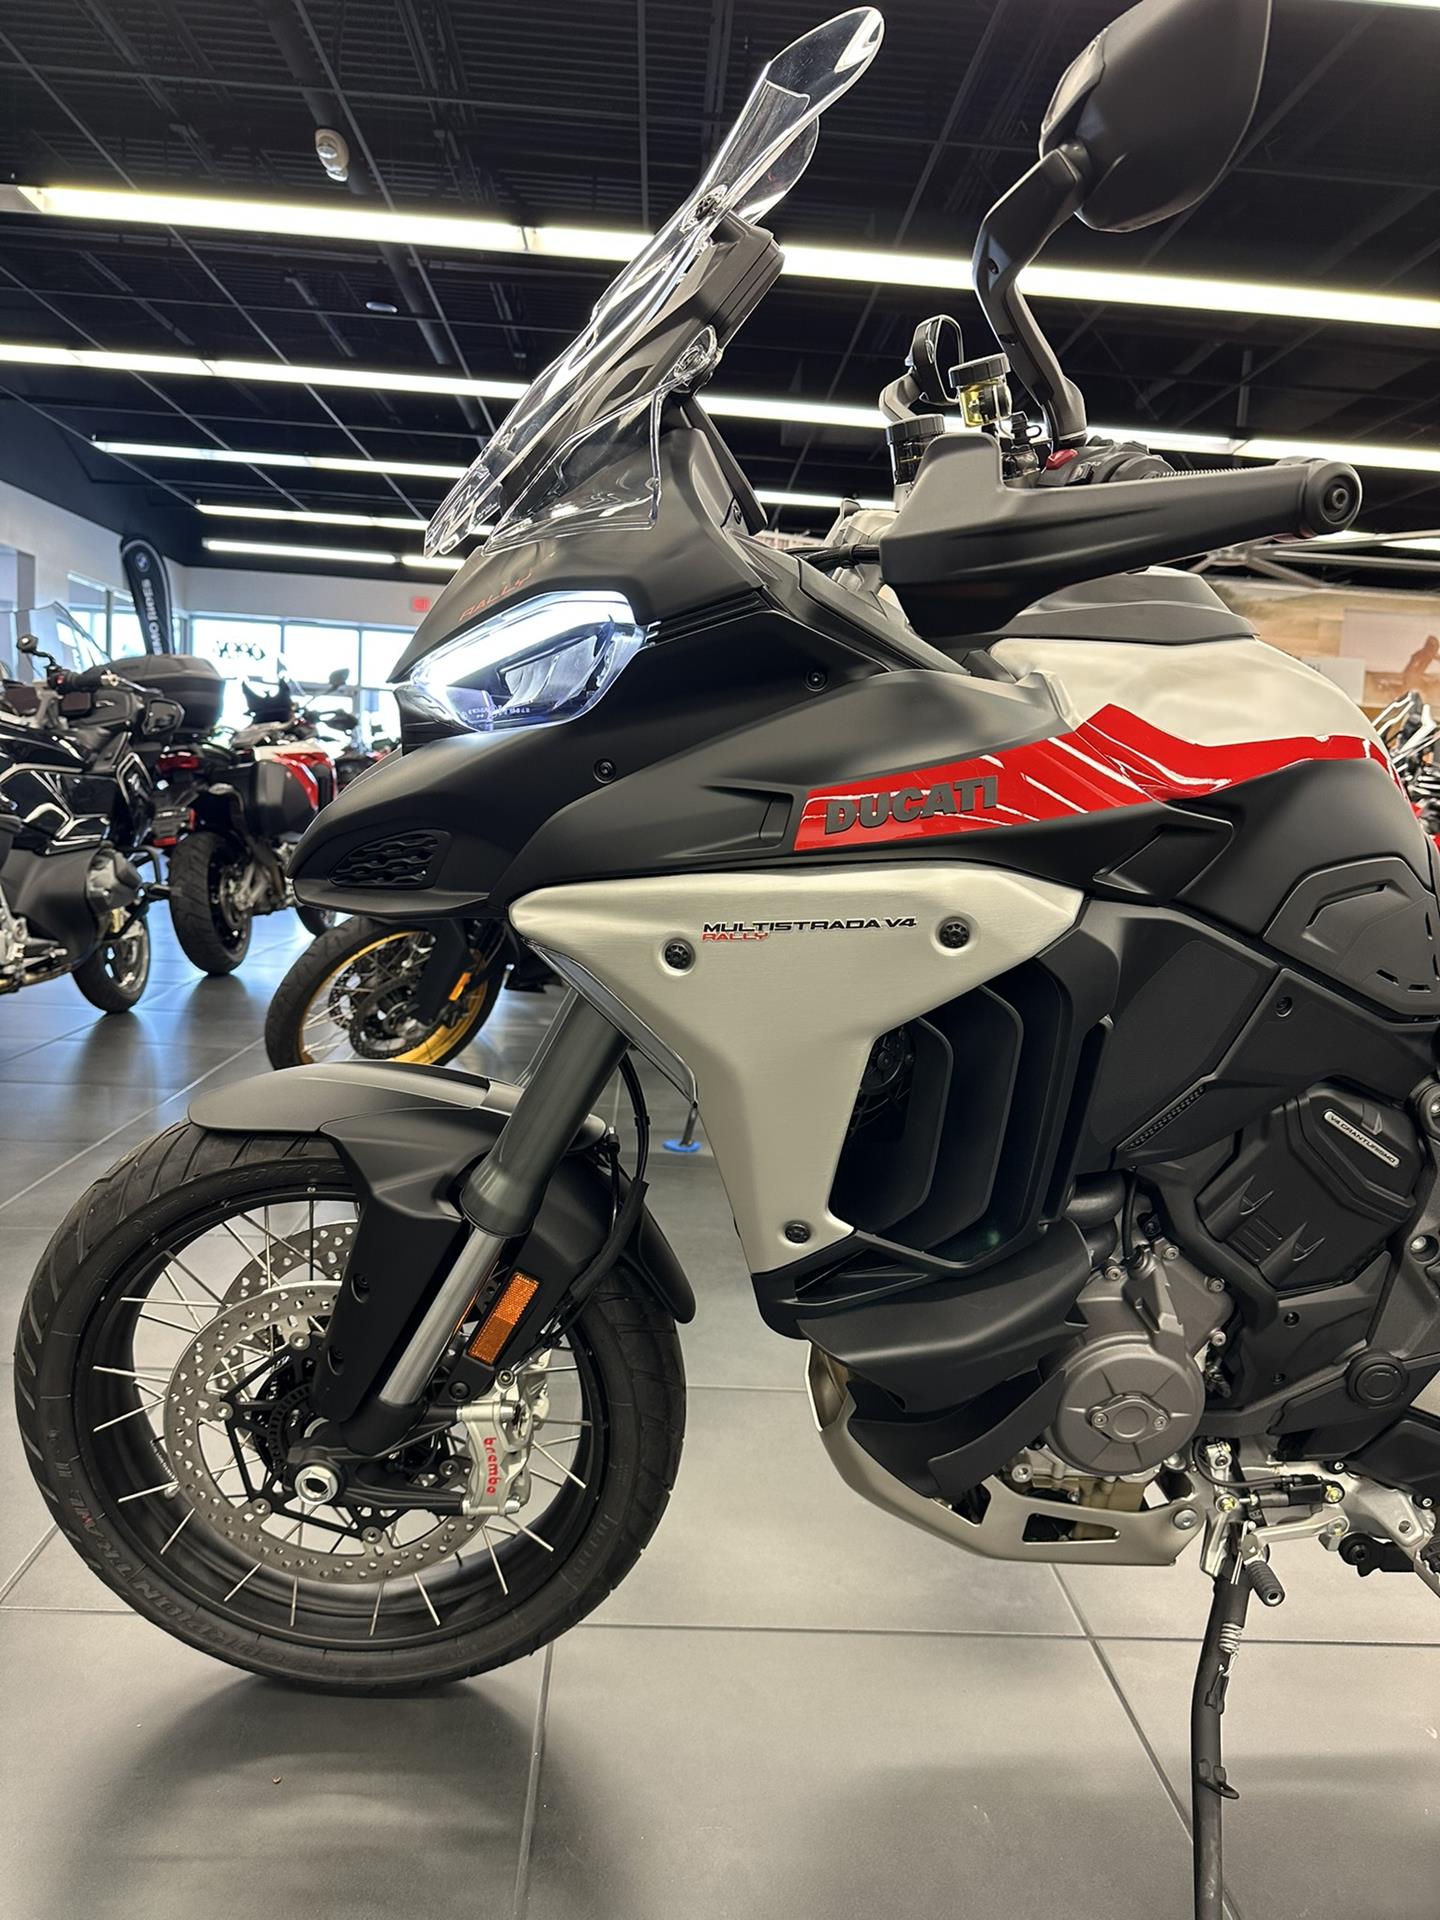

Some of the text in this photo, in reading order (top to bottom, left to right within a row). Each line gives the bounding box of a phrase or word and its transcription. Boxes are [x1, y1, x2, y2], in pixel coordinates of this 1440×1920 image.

[141, 579, 164, 656] EMO RIDES
[825, 775, 998, 835] DUCATI
[702, 932, 768, 941] RALLY
[703, 917, 917, 933] MULTISTRADA V4
[483, 1437, 501, 1494] brembo
